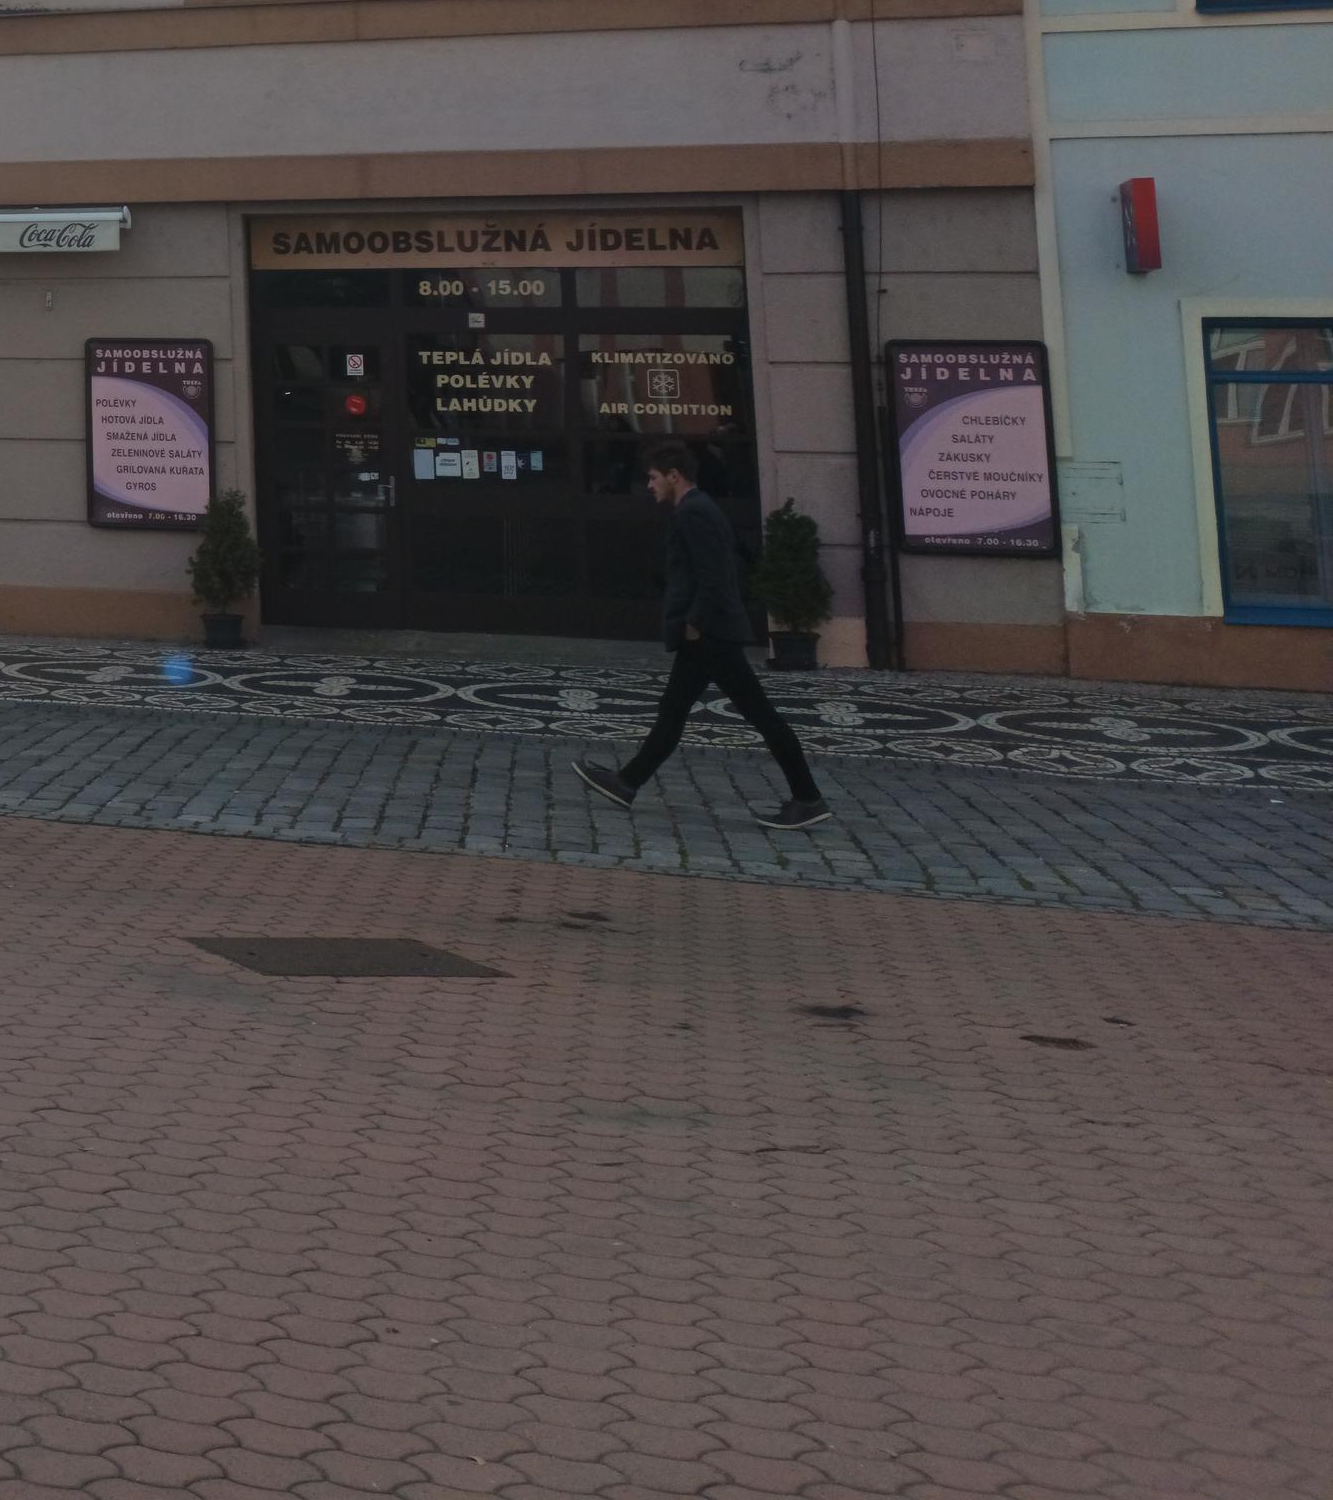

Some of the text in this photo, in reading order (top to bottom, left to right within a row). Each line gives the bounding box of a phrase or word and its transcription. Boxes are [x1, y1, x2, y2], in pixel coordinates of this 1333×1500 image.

[19, 221, 100, 249] Coca-Cola
[271, 218, 720, 255] SAMOOBSLUŽNÁ JÍDELNA
[418, 280, 464, 297] 8.00
[487, 279, 546, 297] 15.00
[95, 346, 204, 360] SAMOOBSLUŽNÁ
[418, 348, 553, 366] TEPLÁ JÍDLA
[591, 350, 734, 365] KLIMATIZOVÁNO
[898, 351, 1035, 365] SAMOOBSLUŽNÁ
[96, 358, 204, 375] JÍDELNA
[900, 363, 1037, 381] JÍDELNA
[436, 370, 536, 389] POLÉVKY
[95, 397, 137, 409] POLÉVKY
[436, 394, 538, 413] LAHŮDKY
[599, 402, 733, 417] AIR CONDITION
[101, 414, 165, 426] HOTOVÁ JÍDLA
[962, 414, 1027, 426] CHLEBÍČKY
[106, 430, 177, 442] SMAŽENÁ JÍDLA
[951, 432, 995, 445] SALÁTY
[111, 447, 204, 460] ZELENINOVÉ SALÁTY
[937, 451, 992, 463] ZÁKUSKY
[928, 468, 1044, 483] ČERSTVÉ MOUČNÍKY
[125, 481, 158, 491] GYROS
[920, 487, 1017, 501] OVOCNÉ POHÁRY
[909, 505, 955, 518] NÁPOJE
